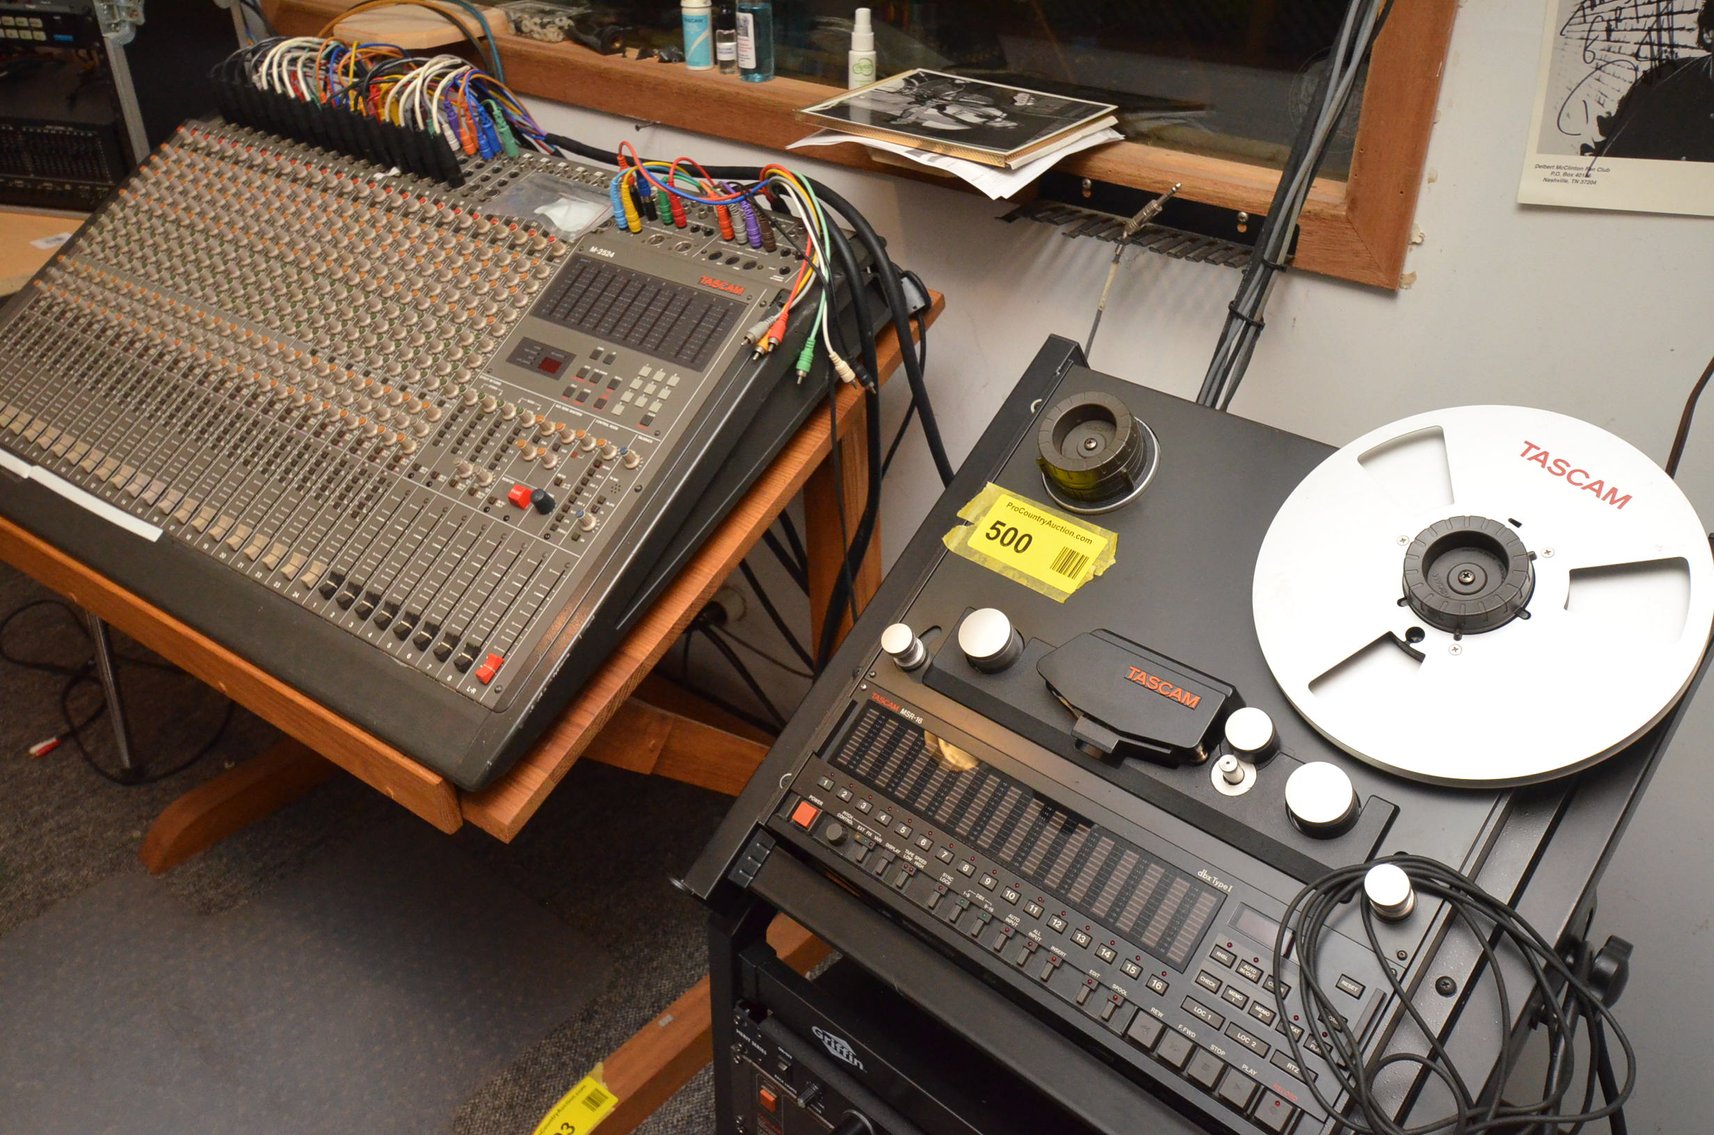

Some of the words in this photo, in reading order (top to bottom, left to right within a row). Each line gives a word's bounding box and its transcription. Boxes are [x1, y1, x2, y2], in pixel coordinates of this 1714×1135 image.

[589, 246, 615, 258] M-2524
[699, 275, 745, 295] TASCAM
[1520, 440, 1632, 510] TASCAM
[1006, 501, 1093, 545] ProCountryAuction.com
[985, 520, 1033, 554] 500
[467, 686, 477, 694] L-R
[1127, 665, 1202, 710] TASCAM
[871, 691, 900, 712] TASCAM
[900, 708, 923, 724] MSR-16
[808, 794, 823, 806] POWER
[837, 812, 853, 826] CONTROL
[885, 842, 901, 854] DISPLAY
[903, 854, 912, 862] LOW
[905, 849, 914, 858] TAPE
[914, 855, 927, 866] SPEED
[940, 877, 951, 886] LOCK
[942, 872, 954, 881] SYNC
[984, 877, 991, 885] 9
[1197, 868, 1211, 882] dbx
[1211, 876, 1228, 890] Type
[1005, 890, 1016, 900] 10
[1029, 904, 1038, 914] 11
[1005, 917, 1018, 927] INPUT
[1008, 914, 1020, 923] AUTO
[1052, 919, 1062, 928] 12
[1028, 932, 1042, 942] INPUT
[1076, 933, 1086, 943] 13
[1050, 945, 1067, 957] INSERT
[1100, 948, 1111, 958] 14
[1089, 969, 1101, 978] EDIT
[1126, 963, 1137, 974] 15
[1239, 967, 1256, 980] IN/OUT
[1244, 964, 1257, 974] AUTO
[1151, 979, 1162, 989] 16
[1200, 976, 1216, 988] CHECK
[1341, 979, 1359, 992] RESET
[1112, 984, 1127, 996] SPOOL
[1228, 989, 1243, 1001] MEMO
[1151, 1007, 1164, 1018] REW
[1194, 1006, 1206, 1017] LOC
[1255, 1005, 1271, 1017] MEMO
[1178, 1024, 1197, 1038] F.FWD
[1237, 1032, 1250, 1044] LOC
[811, 1026, 864, 1070] Griffin
[1209, 1044, 1226, 1056] STOP
[1242, 1063, 1257, 1076] PLAY
[1286, 1062, 1300, 1074] RTZ
